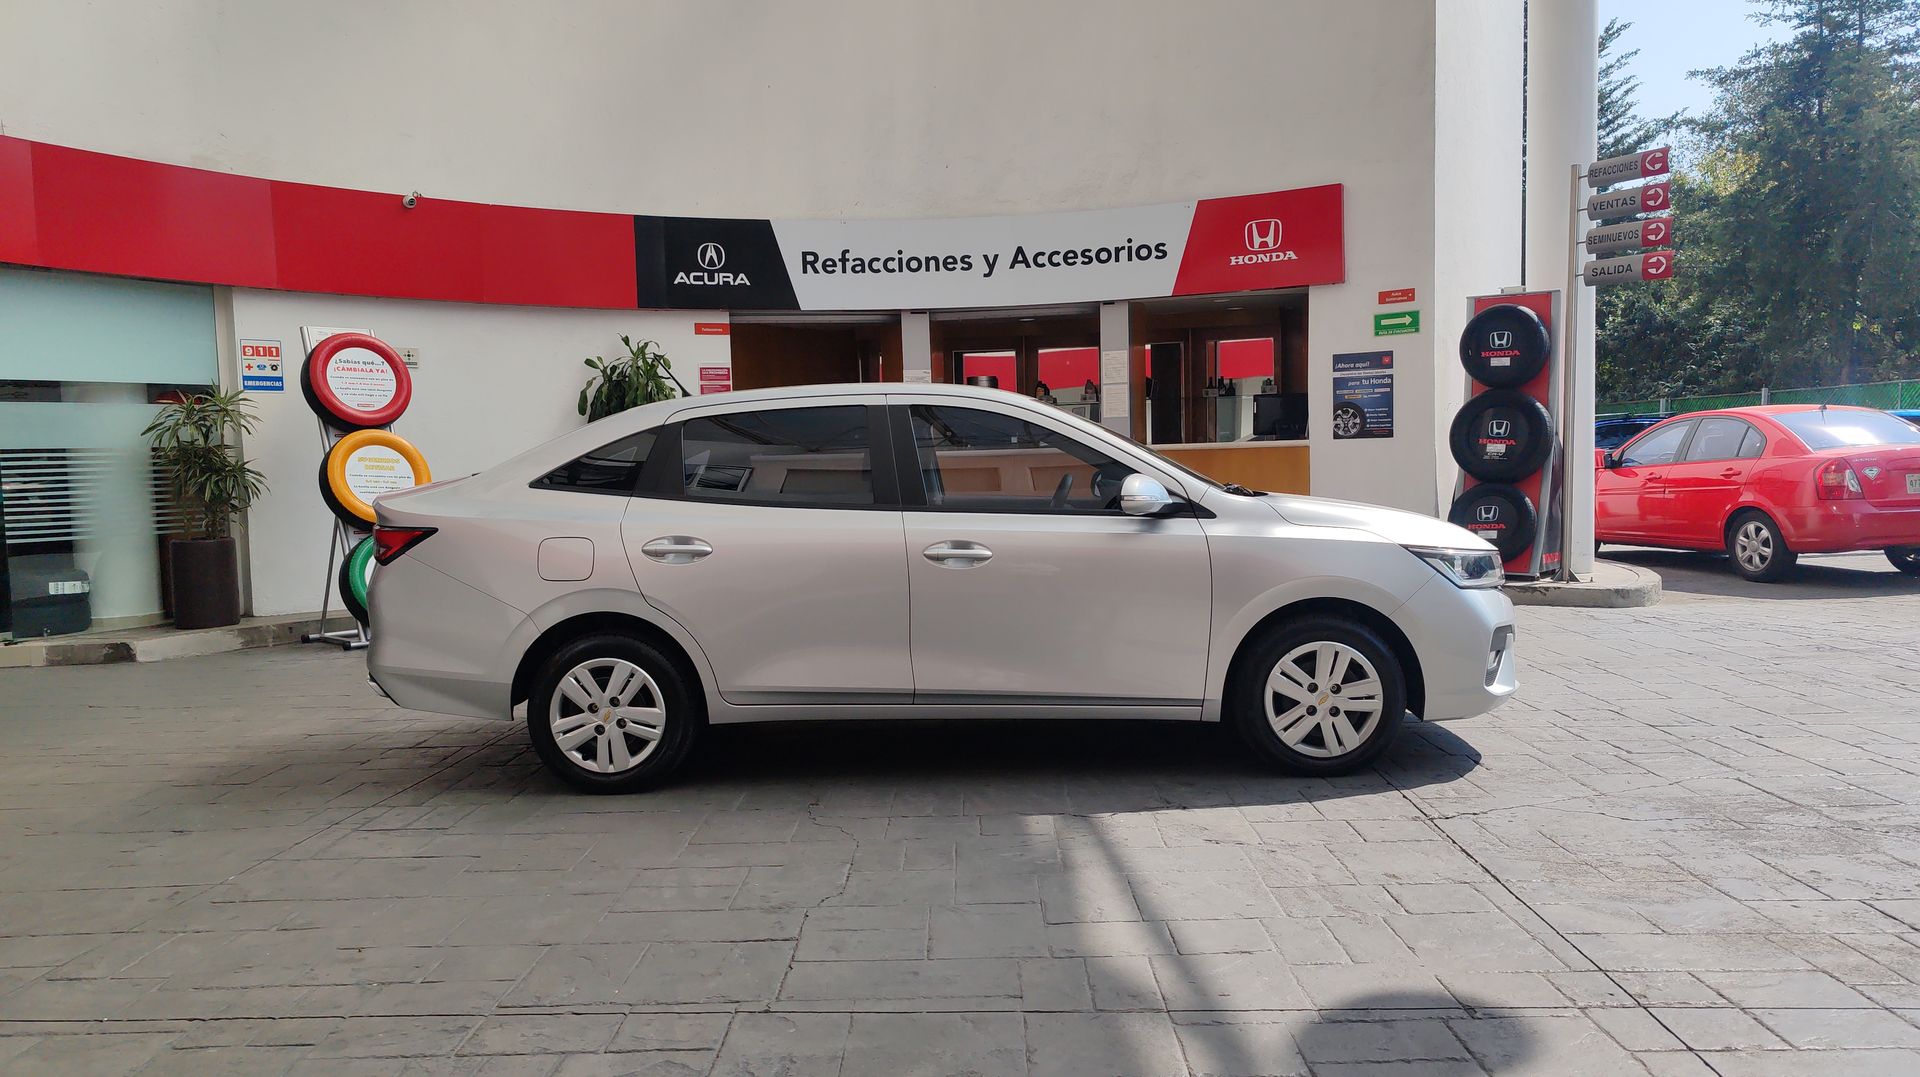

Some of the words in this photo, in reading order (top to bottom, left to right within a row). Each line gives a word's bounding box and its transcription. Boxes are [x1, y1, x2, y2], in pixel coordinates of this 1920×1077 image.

[1588, 160, 1639, 179] REFACCIONES
[1592, 195, 1636, 212] VENTAS
[1587, 229, 1640, 246] SEMINUEVOS
[801, 248, 973, 275] Refacciones
[982, 252, 999, 278] y
[1008, 237, 1168, 270] Accesorios
[1229, 250, 1298, 266] HONDA
[1591, 263, 1633, 278] SALIDA
[673, 271, 751, 286] ACURA
[244, 347, 278, 357] 911
[1480, 349, 1521, 358] HONDA
[1370, 376, 1392, 385] Honda
